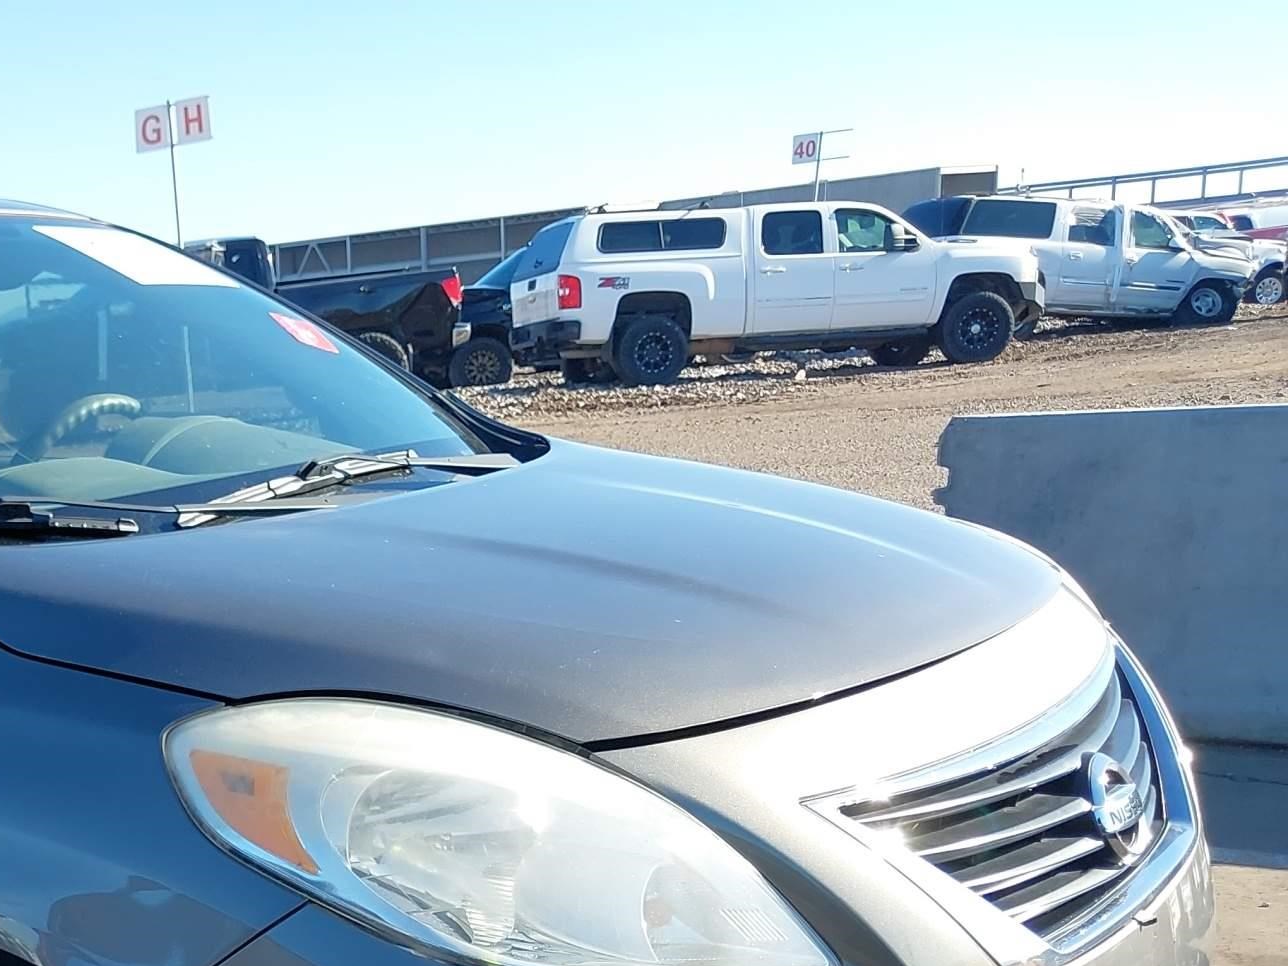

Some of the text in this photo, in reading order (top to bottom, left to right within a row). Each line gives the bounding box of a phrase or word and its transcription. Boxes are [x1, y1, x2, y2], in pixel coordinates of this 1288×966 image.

[141, 103, 203, 145] G H
[793, 140, 816, 158] 40
[1109, 793, 1143, 825] NIS
